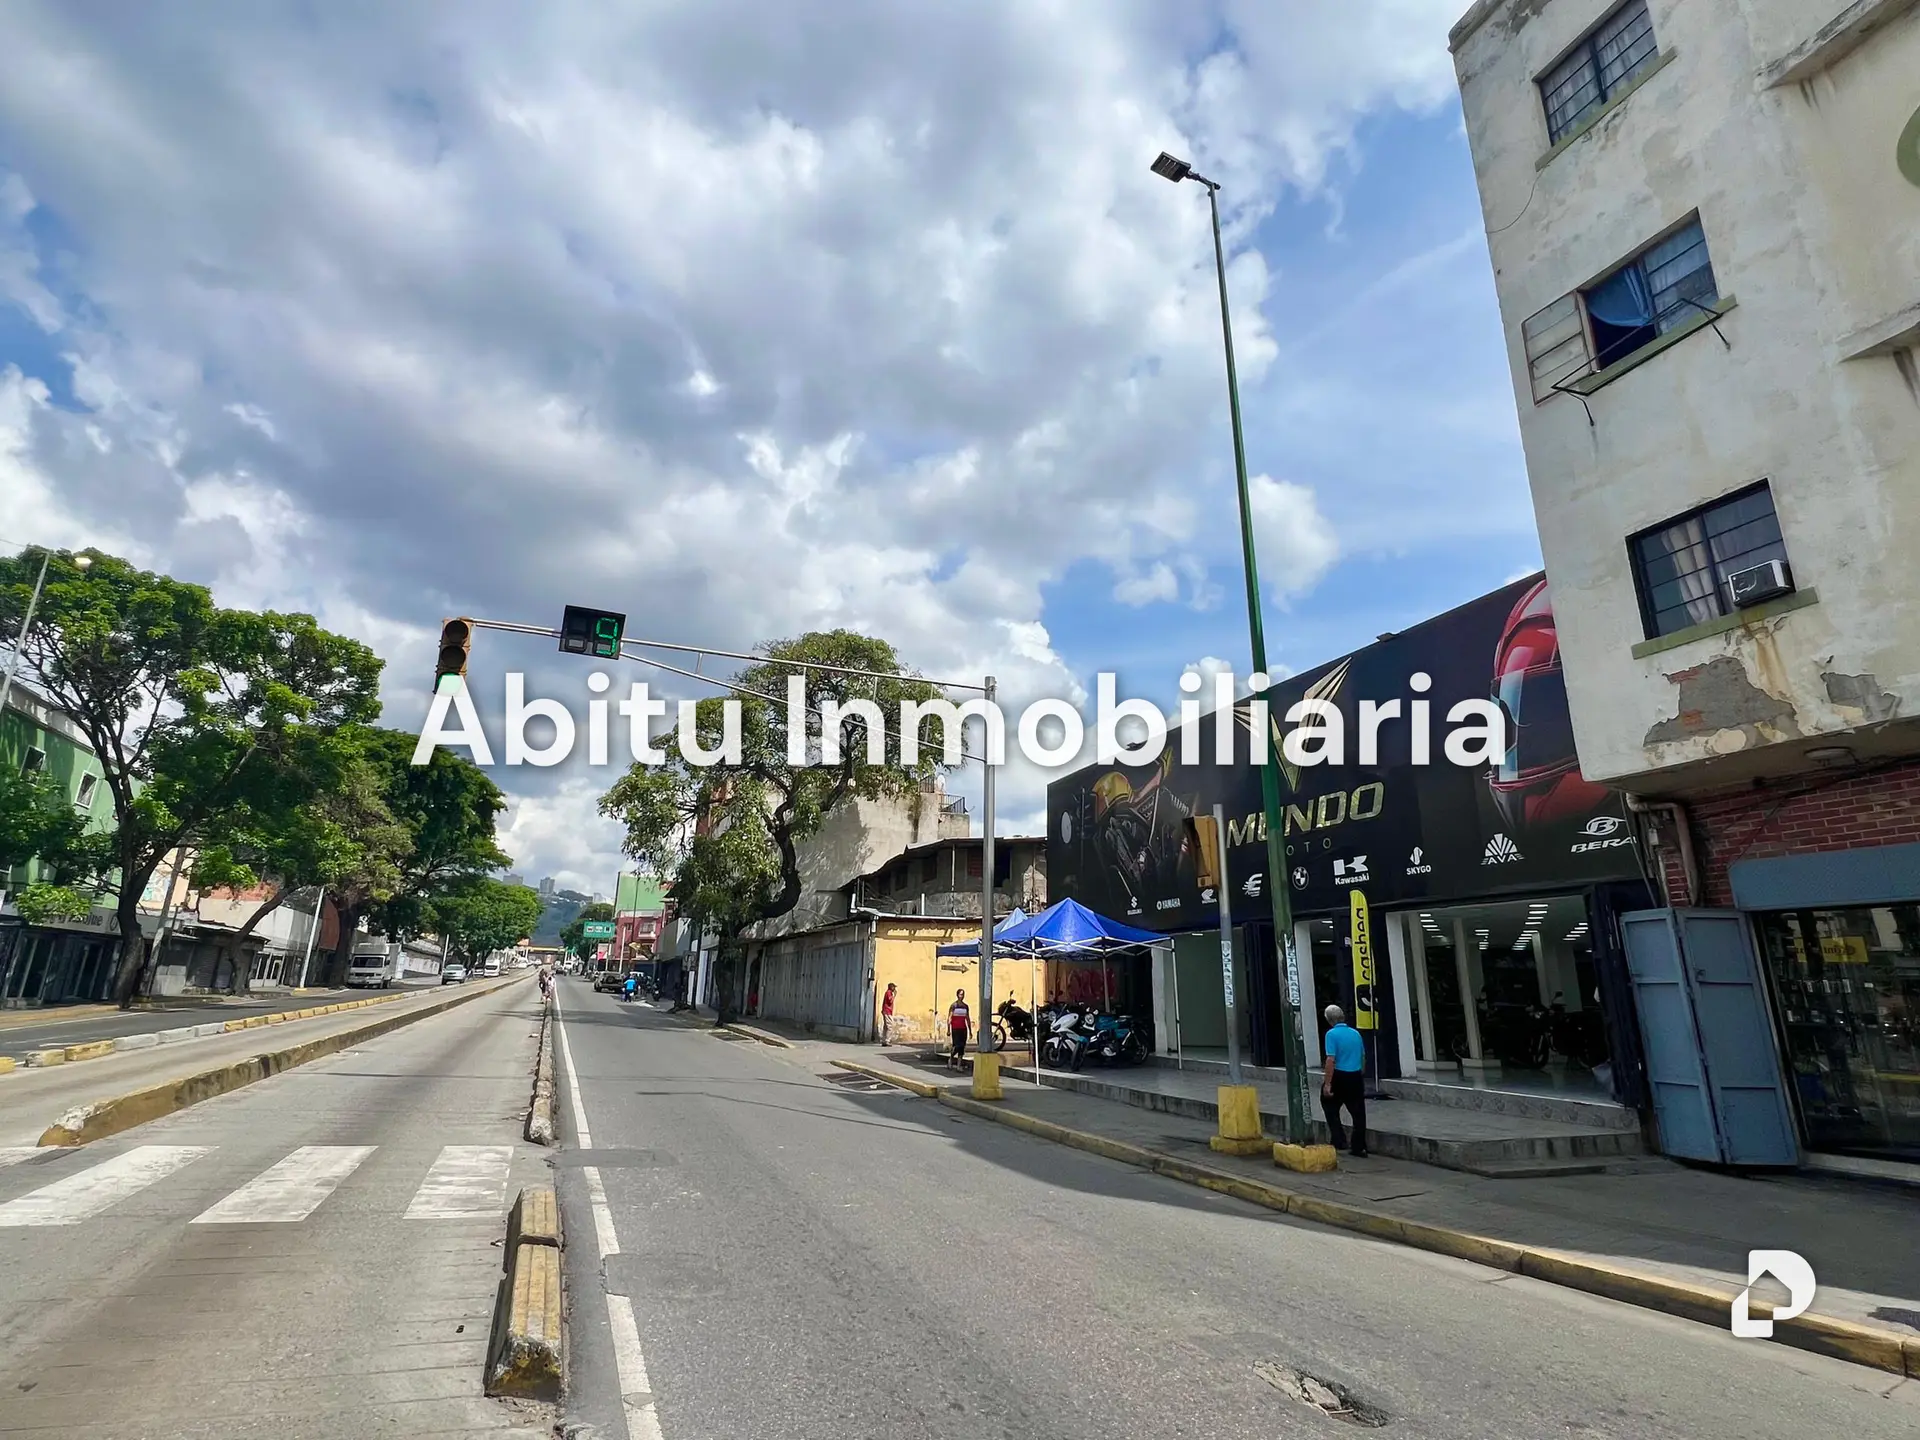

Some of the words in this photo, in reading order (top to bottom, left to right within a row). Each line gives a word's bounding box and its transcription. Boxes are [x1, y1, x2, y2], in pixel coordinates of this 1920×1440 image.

[595, 617, 619, 656] 9
[1286, 837, 1332, 856] OTO
[1570, 836, 1637, 853] BERA
[1487, 853, 1518, 865] AVA
[1406, 864, 1432, 875] SKYGO
[1335, 873, 1370, 885] Kawasaki
[1354, 907, 1371, 981] cashea
